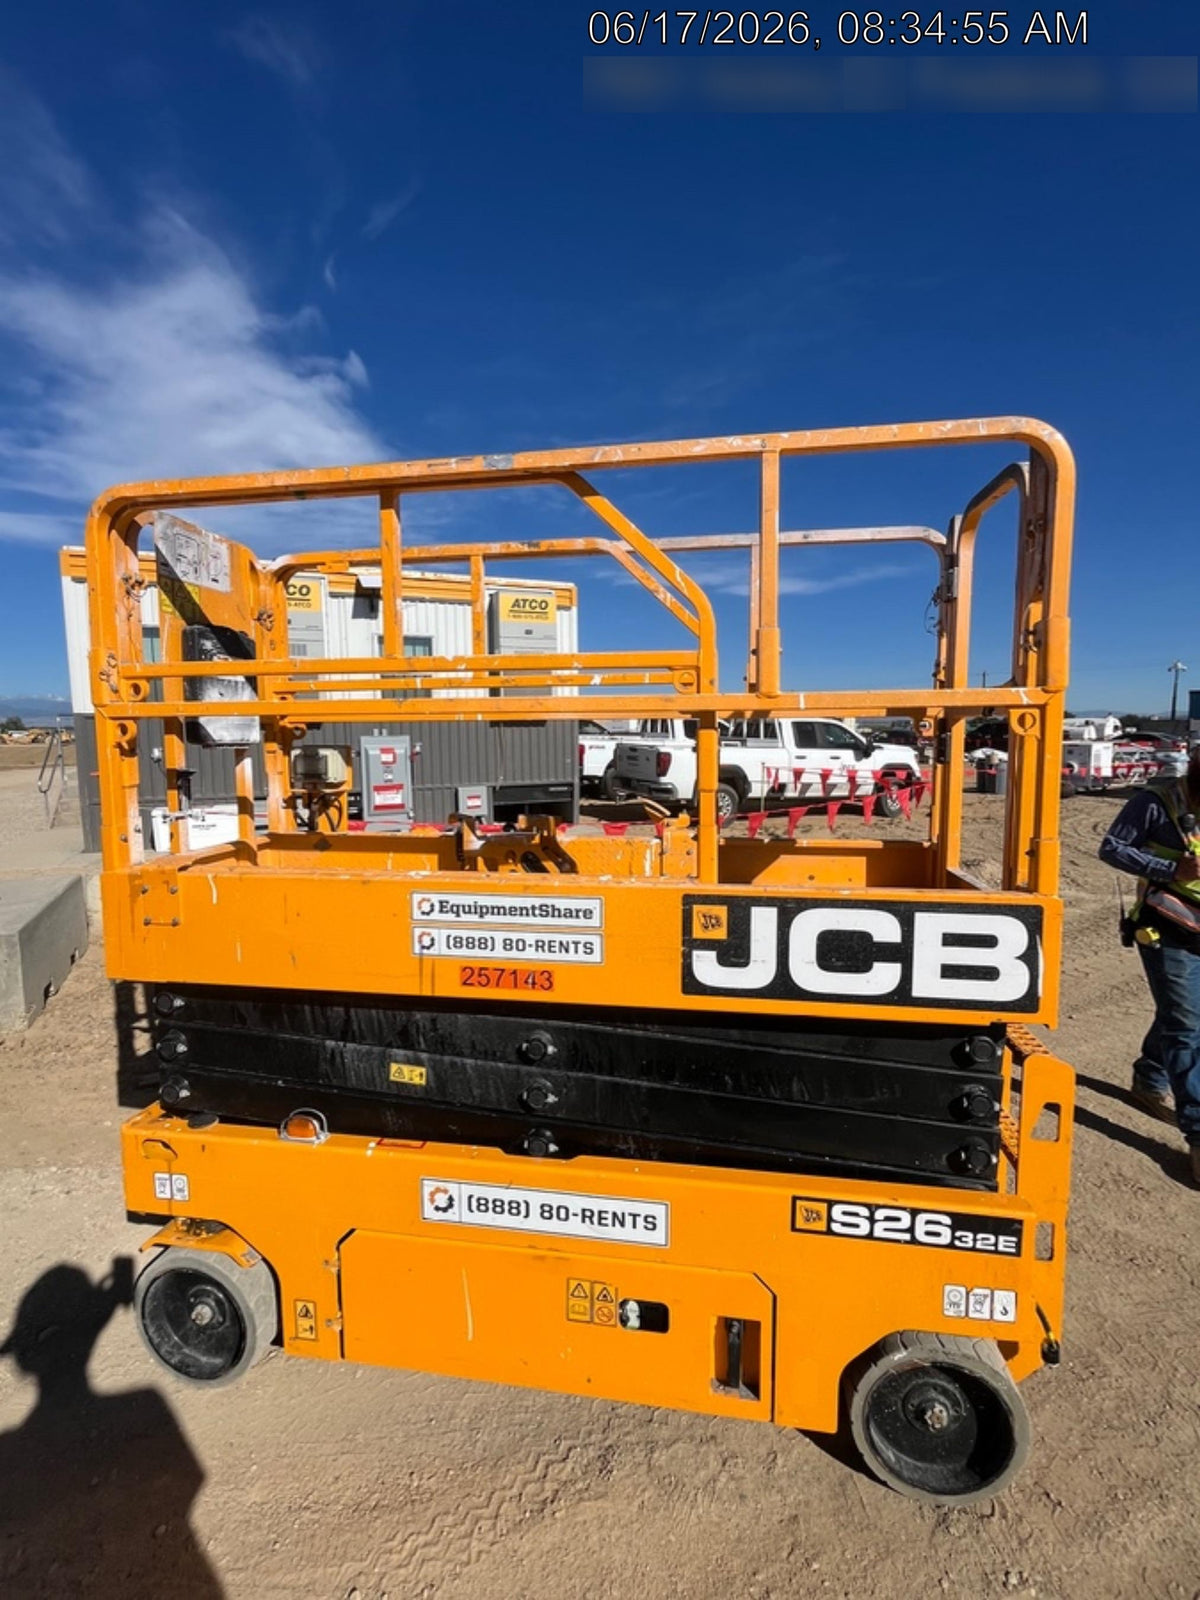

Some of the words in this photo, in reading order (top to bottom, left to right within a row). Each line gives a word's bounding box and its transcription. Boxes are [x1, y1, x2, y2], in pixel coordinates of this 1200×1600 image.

[286, 584, 311, 597] CO
[511, 598, 549, 610] ATCO
[437, 899, 594, 920] EquipmentShare
[445, 934, 496, 952] (888)
[502, 937, 595, 956] 80-RENTS
[692, 906, 1031, 1002] JCB
[461, 966, 554, 991] 257143
[466, 1194, 531, 1219] (888)
[539, 1202, 658, 1232] 80-RENTS
[830, 1203, 953, 1246] S26
